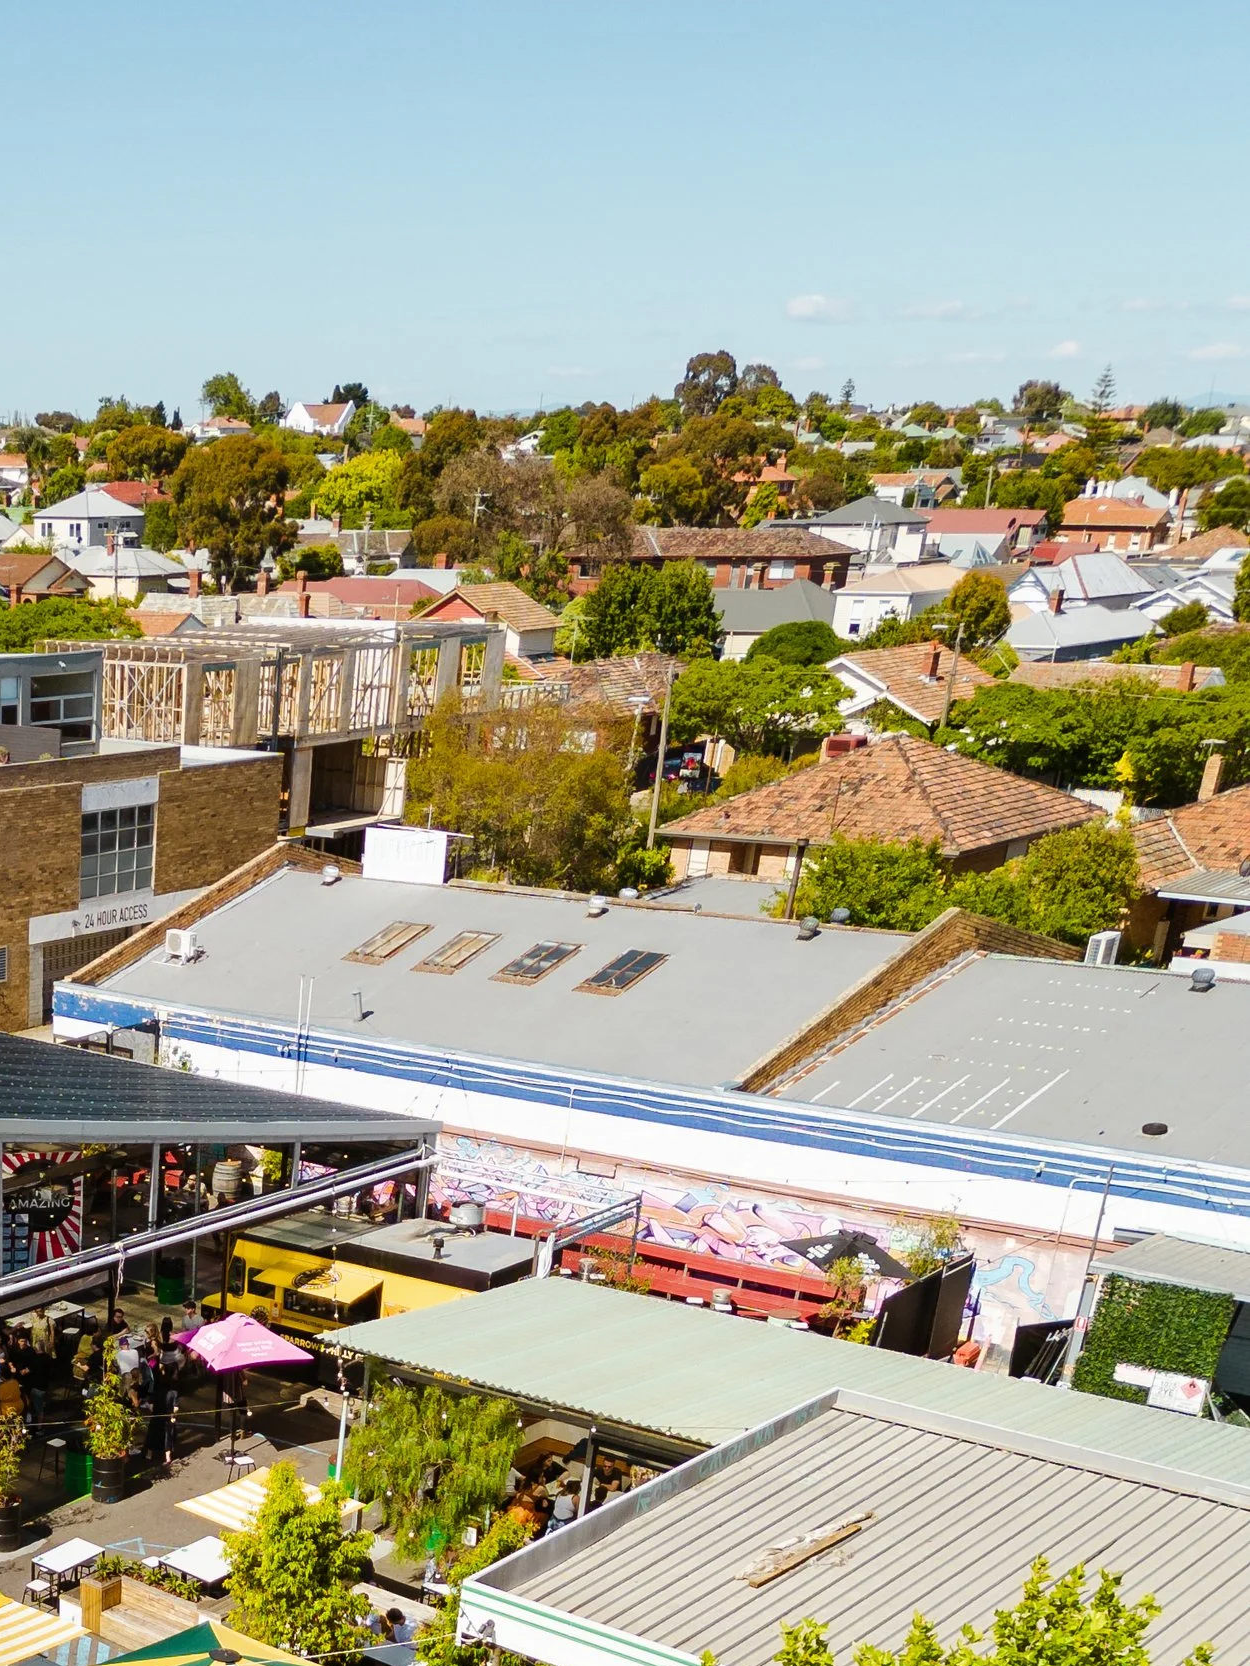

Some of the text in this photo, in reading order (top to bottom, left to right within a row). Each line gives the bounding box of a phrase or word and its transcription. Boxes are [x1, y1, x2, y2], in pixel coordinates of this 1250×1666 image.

[84, 903, 148, 928] 24 HOUR ACCESS
